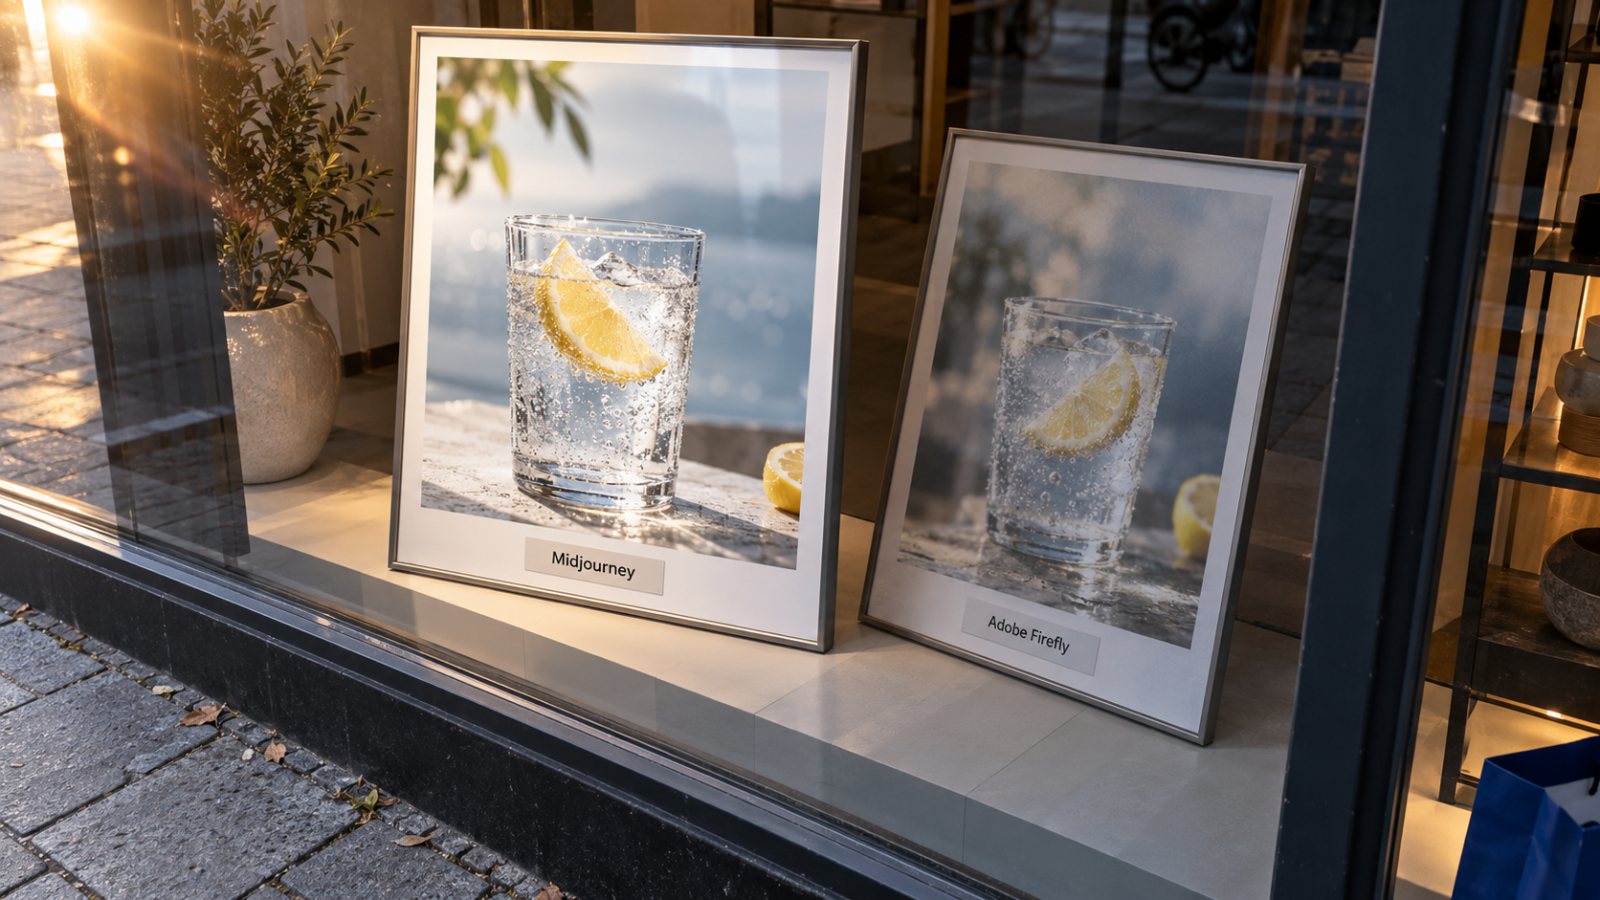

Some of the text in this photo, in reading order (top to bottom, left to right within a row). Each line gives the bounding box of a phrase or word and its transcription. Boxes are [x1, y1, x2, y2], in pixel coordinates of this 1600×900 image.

[552, 551, 635, 581] Midjourney
[987, 616, 1070, 655] Adobe Firefly
